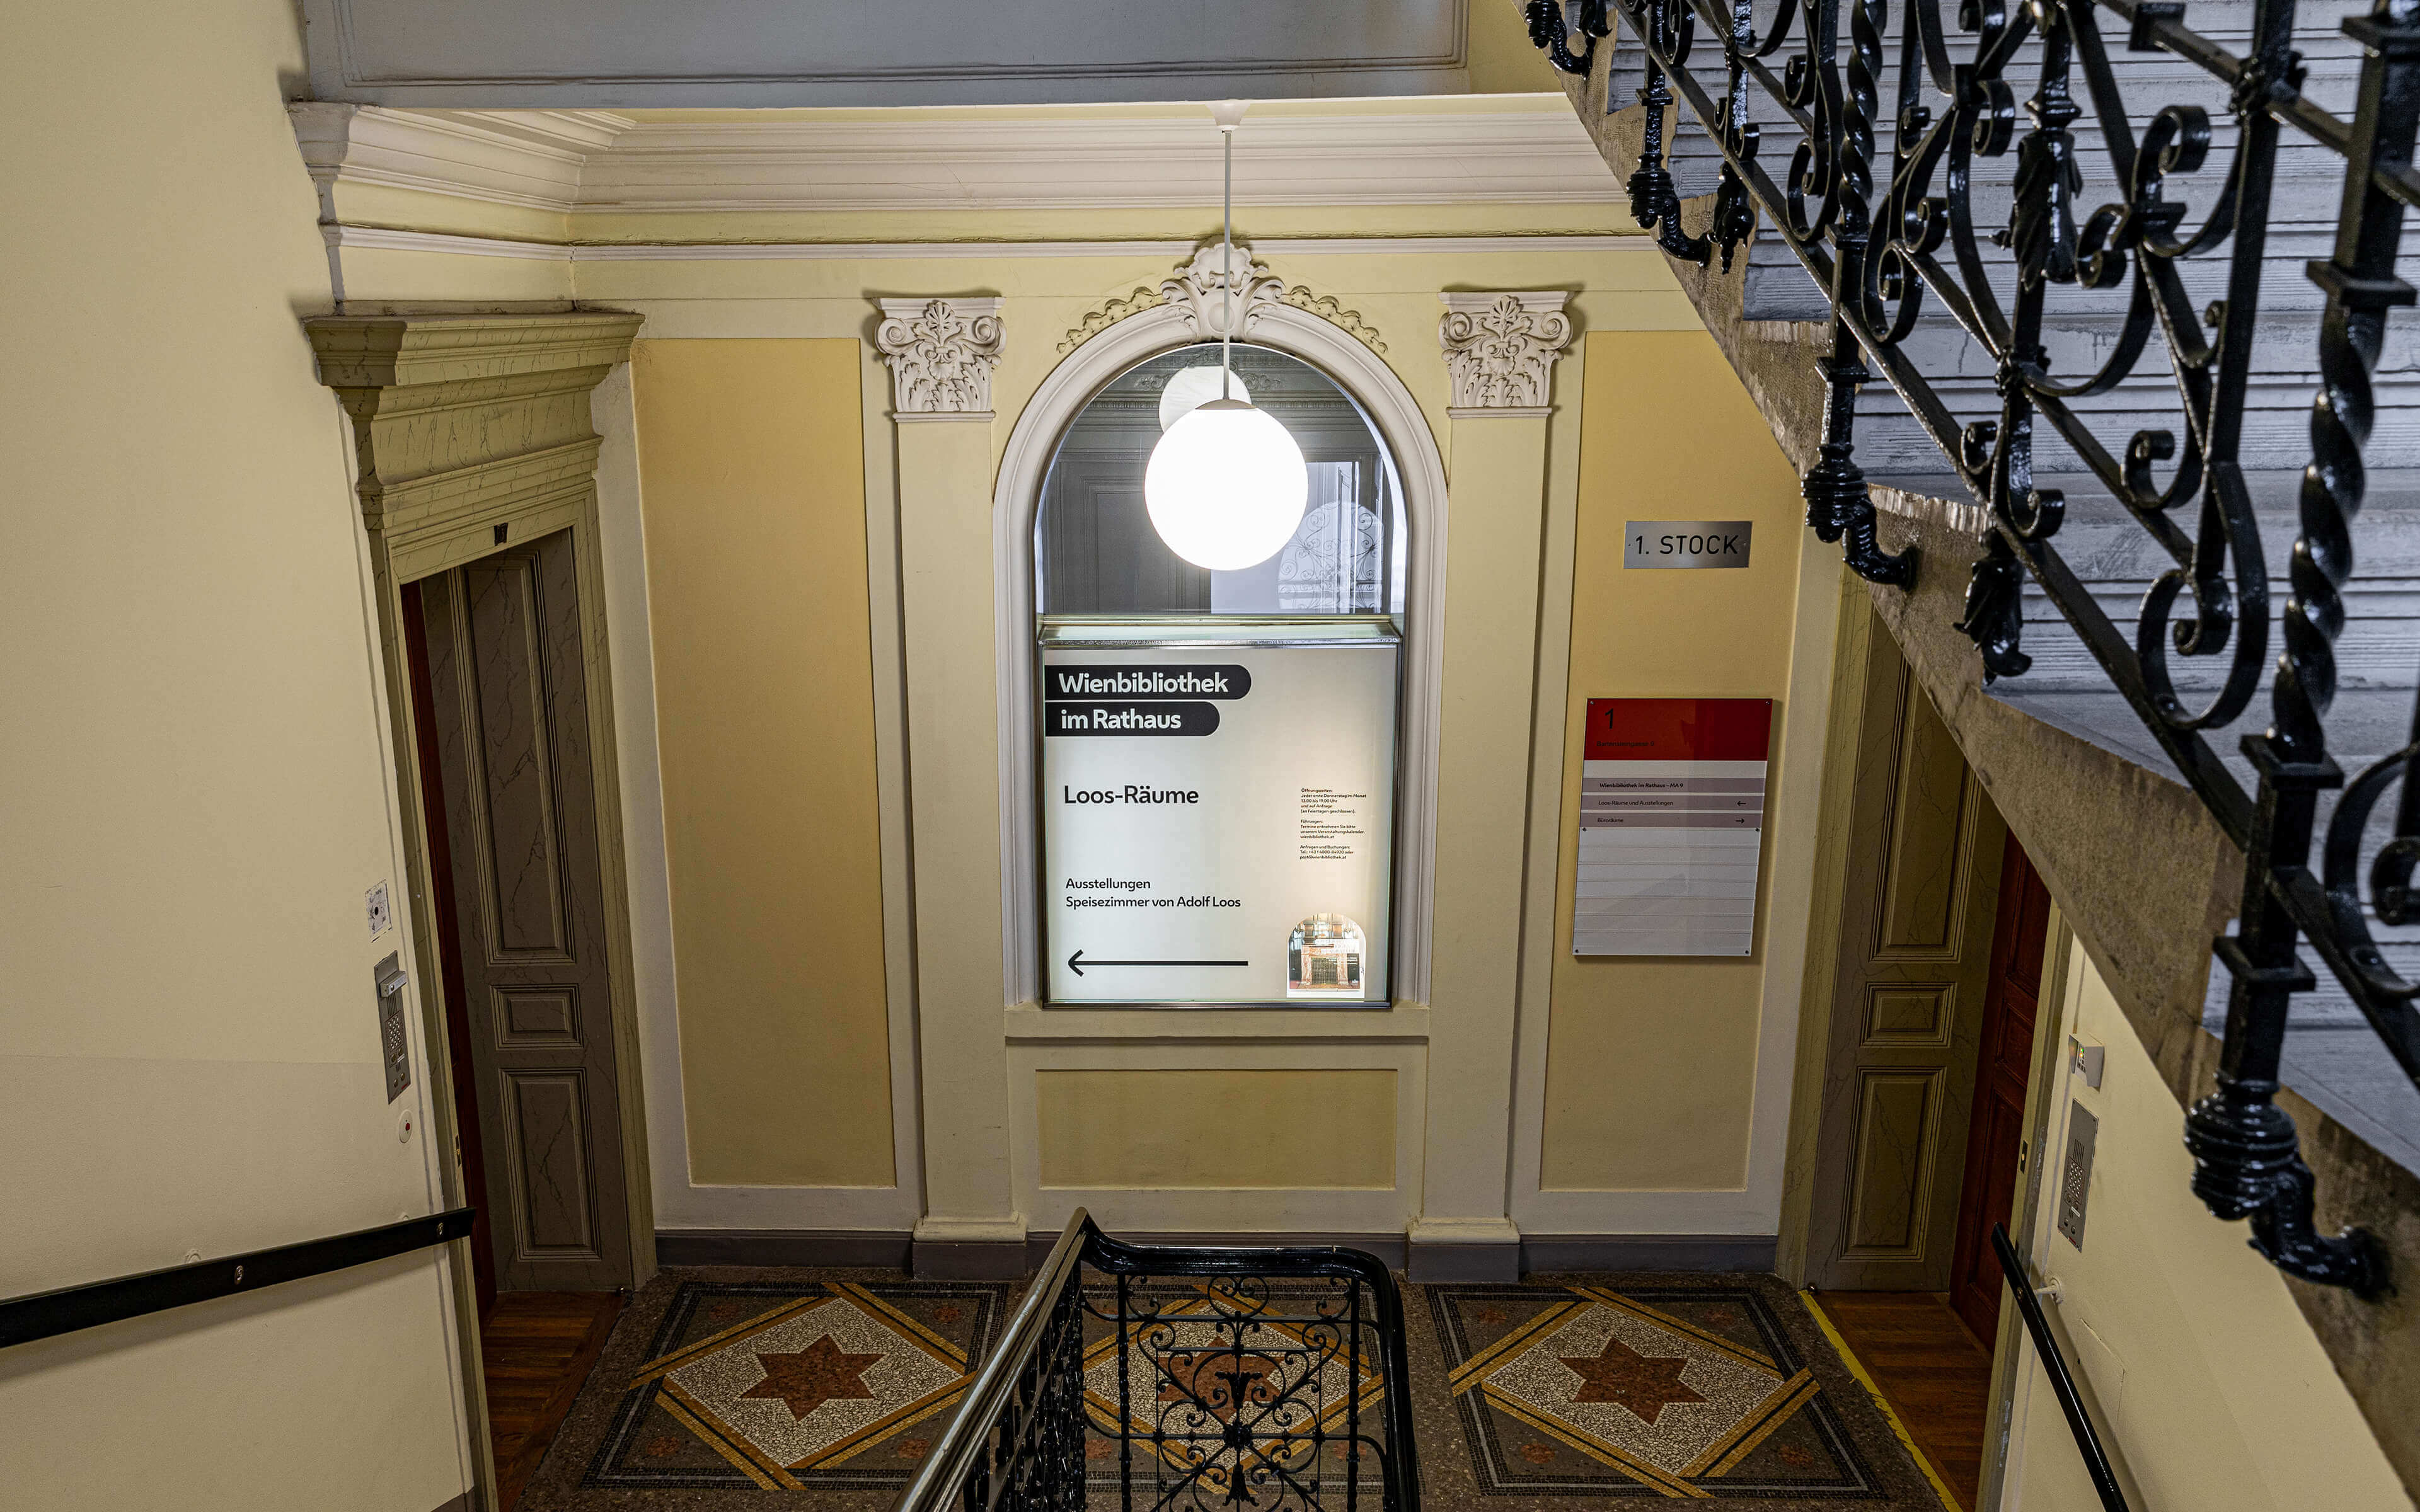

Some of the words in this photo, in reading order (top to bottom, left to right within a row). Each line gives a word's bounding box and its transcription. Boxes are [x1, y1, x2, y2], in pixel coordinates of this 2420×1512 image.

[1636, 536, 1649, 554] 1.
[1659, 535, 1739, 554] STOCK
[1059, 673, 1228, 692] Wienbibliothek
[1061, 709, 1088, 728] im
[1093, 709, 1181, 728] Rathaus
[1605, 708, 1615, 729] 1
[1064, 786, 1199, 804] Loos-Räume
[1066, 878, 1151, 892] Ausstellungen
[1066, 896, 1150, 910] Speisezimmer
[1152, 899, 1174, 907] von
[1177, 896, 1210, 907] Adolf
[1213, 897, 1241, 907] Loos
